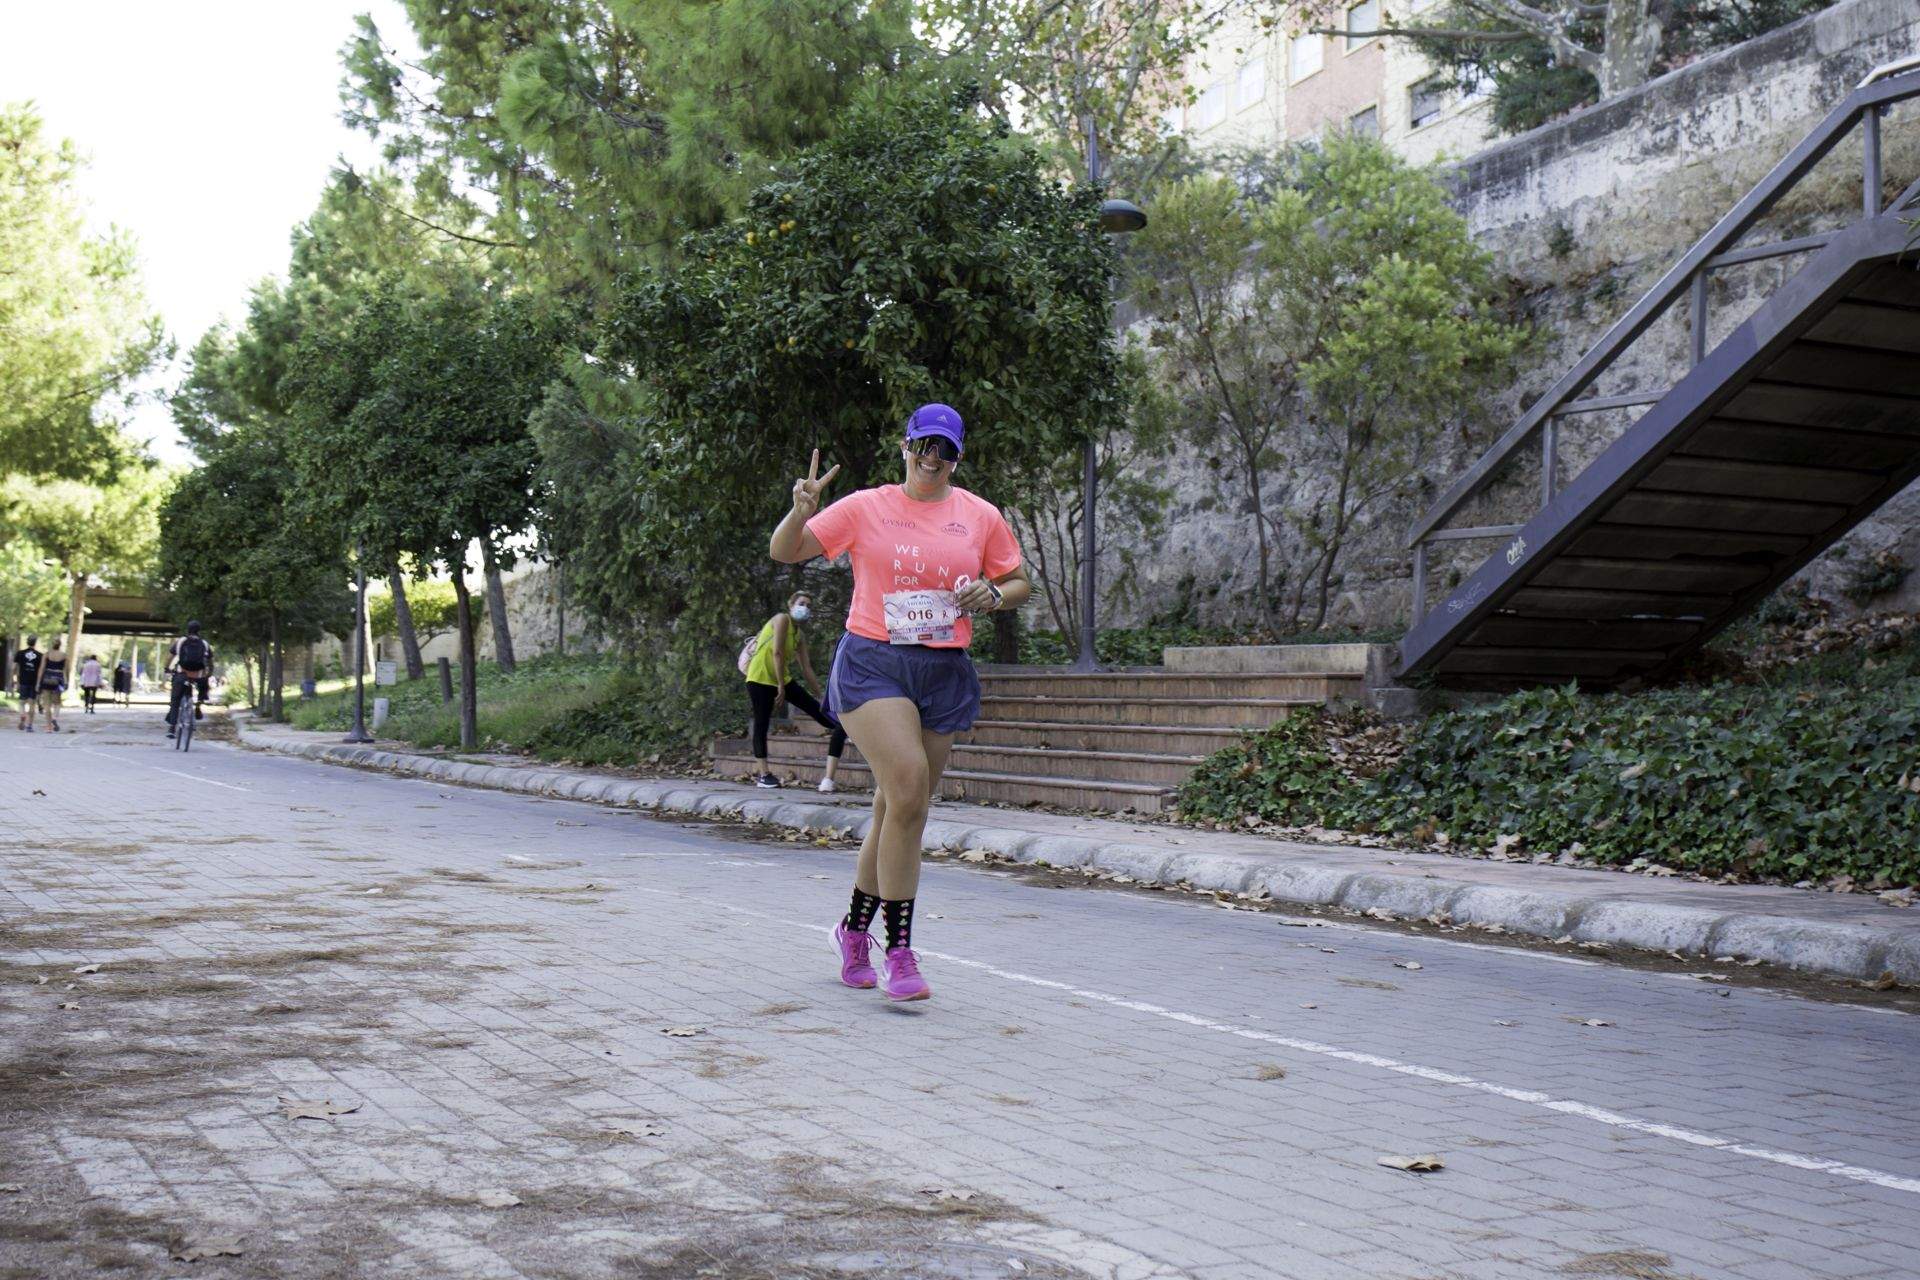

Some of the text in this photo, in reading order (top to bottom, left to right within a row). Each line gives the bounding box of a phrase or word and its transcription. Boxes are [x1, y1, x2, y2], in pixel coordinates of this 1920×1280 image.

[894, 544, 920, 557] WE
[894, 575, 919, 586] FOR
[907, 609, 934, 621] 016
